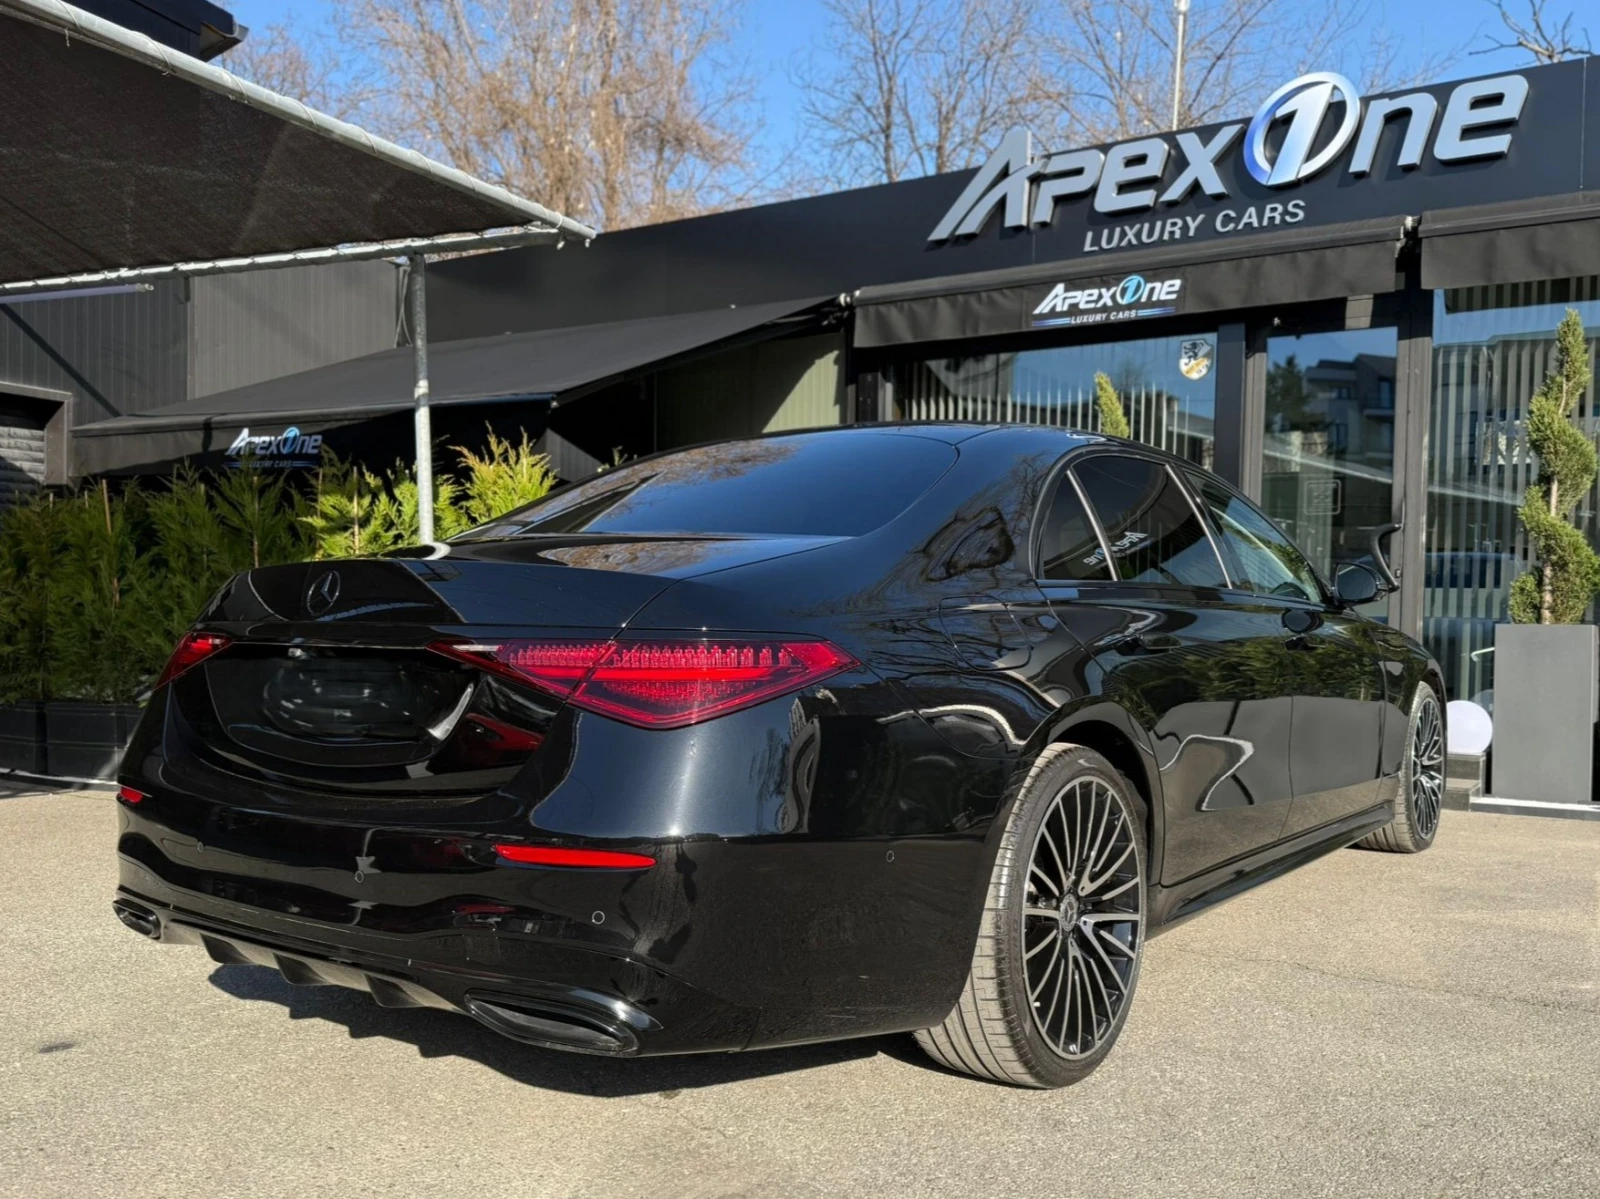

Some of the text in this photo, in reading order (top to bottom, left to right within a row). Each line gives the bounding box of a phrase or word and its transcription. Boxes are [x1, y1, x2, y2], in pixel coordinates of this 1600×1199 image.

[1083, 199, 1307, 253] LUXURY CARS
[1070, 308, 1137, 325] LUXURY CARS
